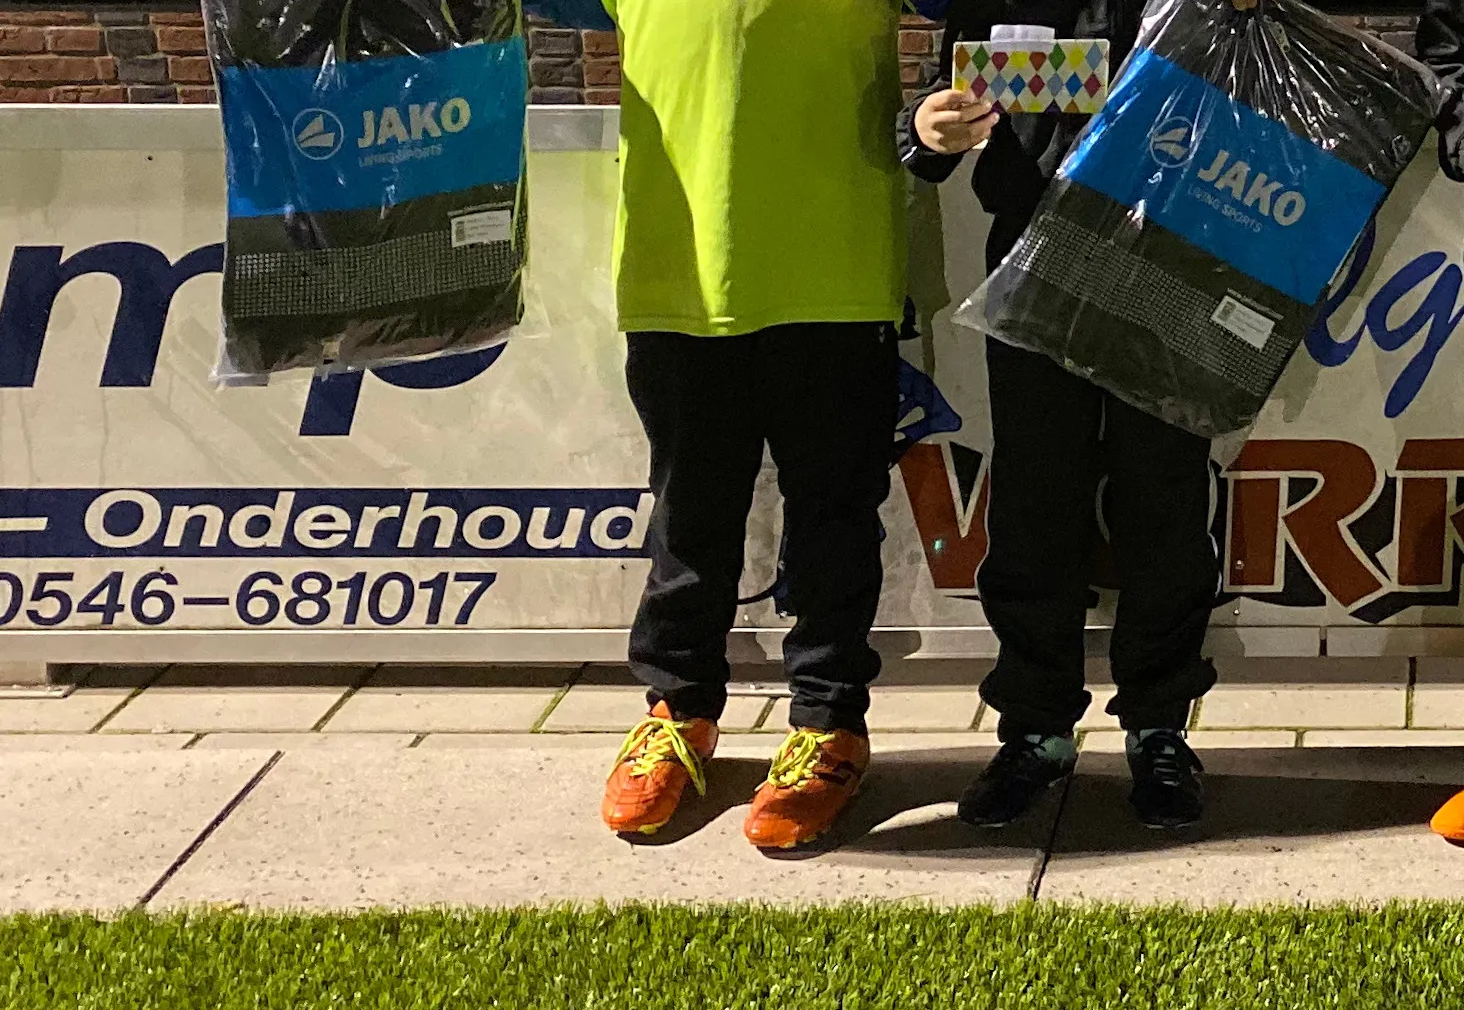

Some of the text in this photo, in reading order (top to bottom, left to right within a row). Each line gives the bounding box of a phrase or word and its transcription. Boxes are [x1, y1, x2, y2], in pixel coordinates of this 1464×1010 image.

[357, 97, 471, 149] JAKO
[1197, 149, 1306, 227] JAKO
[84, 490, 655, 550] Onderhoud
